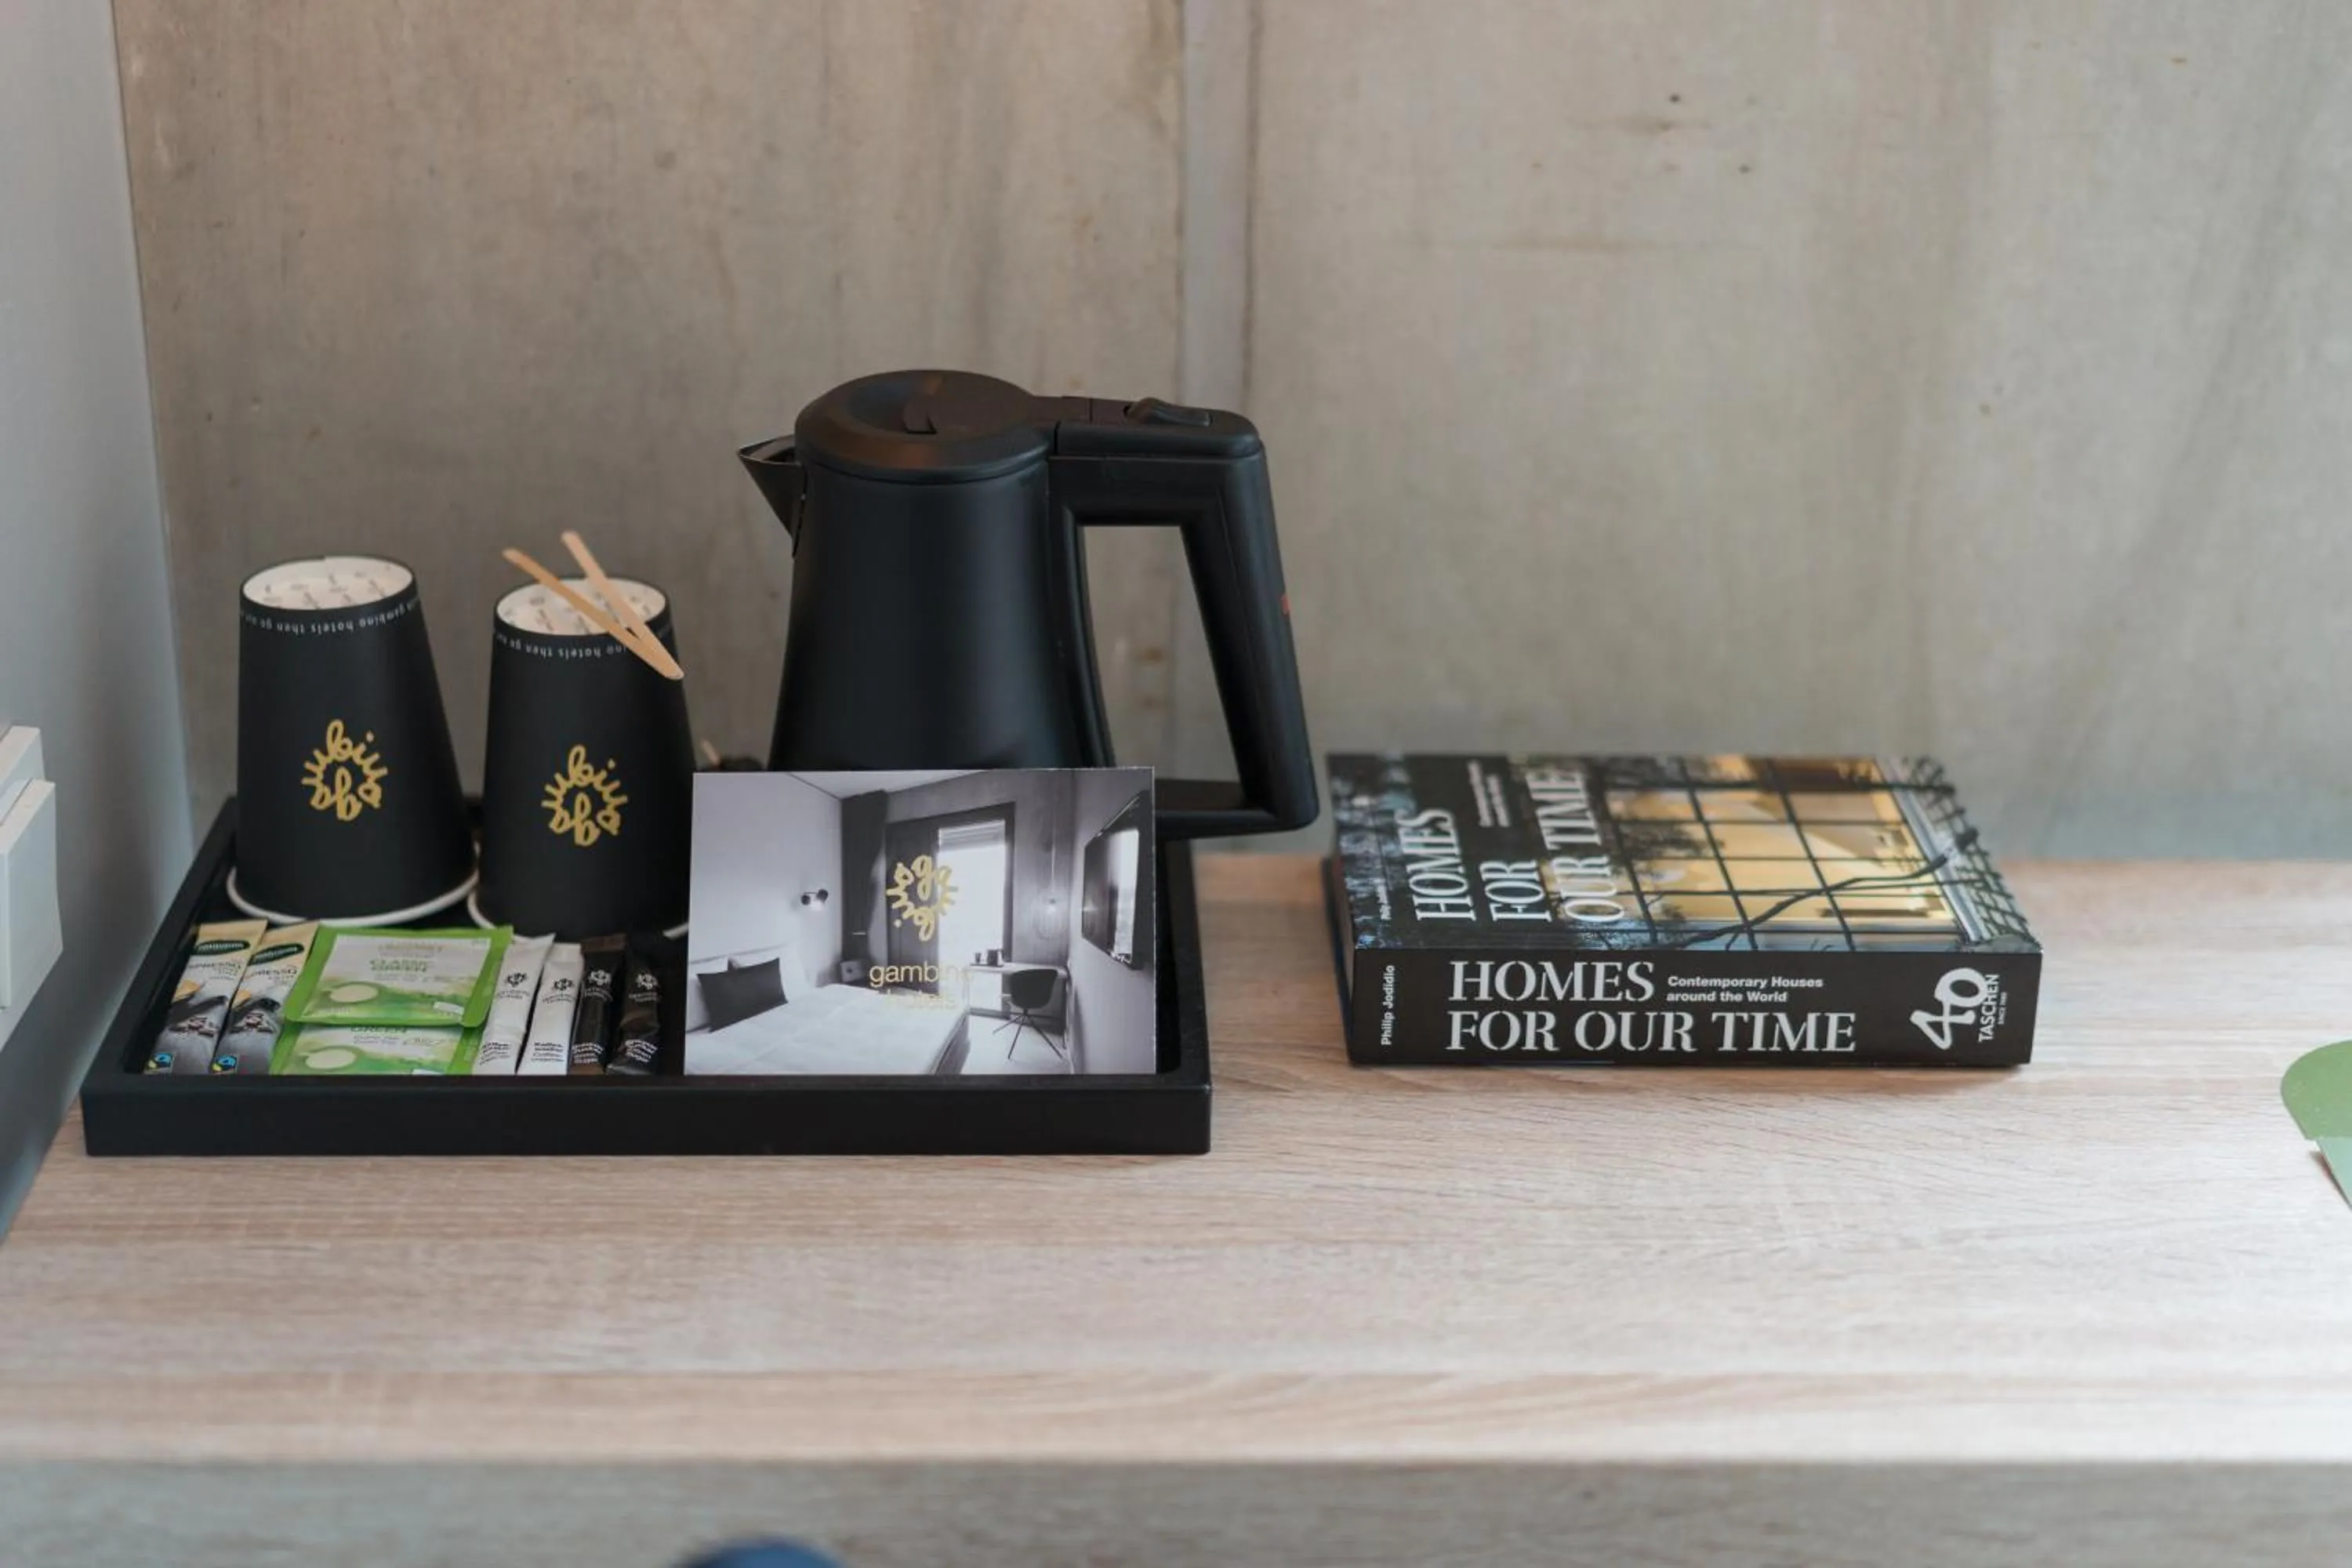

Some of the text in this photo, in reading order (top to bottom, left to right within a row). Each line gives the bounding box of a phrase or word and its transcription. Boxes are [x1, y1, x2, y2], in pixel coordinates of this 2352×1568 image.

[311, 621, 353, 635] hotels
[558, 645, 601, 659] hotels
[1394, 808, 1476, 922] HOMES
[1525, 770, 1625, 923] OUR TIME
[1479, 859, 1553, 923] FOR
[1381, 965, 1396, 1046] Philip Jodidio
[1448, 960, 1655, 1002] HOMES
[1666, 991, 1788, 1002] around the World
[1668, 975, 1824, 989] Contemporary Houses
[1446, 1010, 1857, 1052] FOR OUR TIME
[1910, 967, 1987, 1050] 40
[1977, 974, 2000, 1044] TASCHEN
